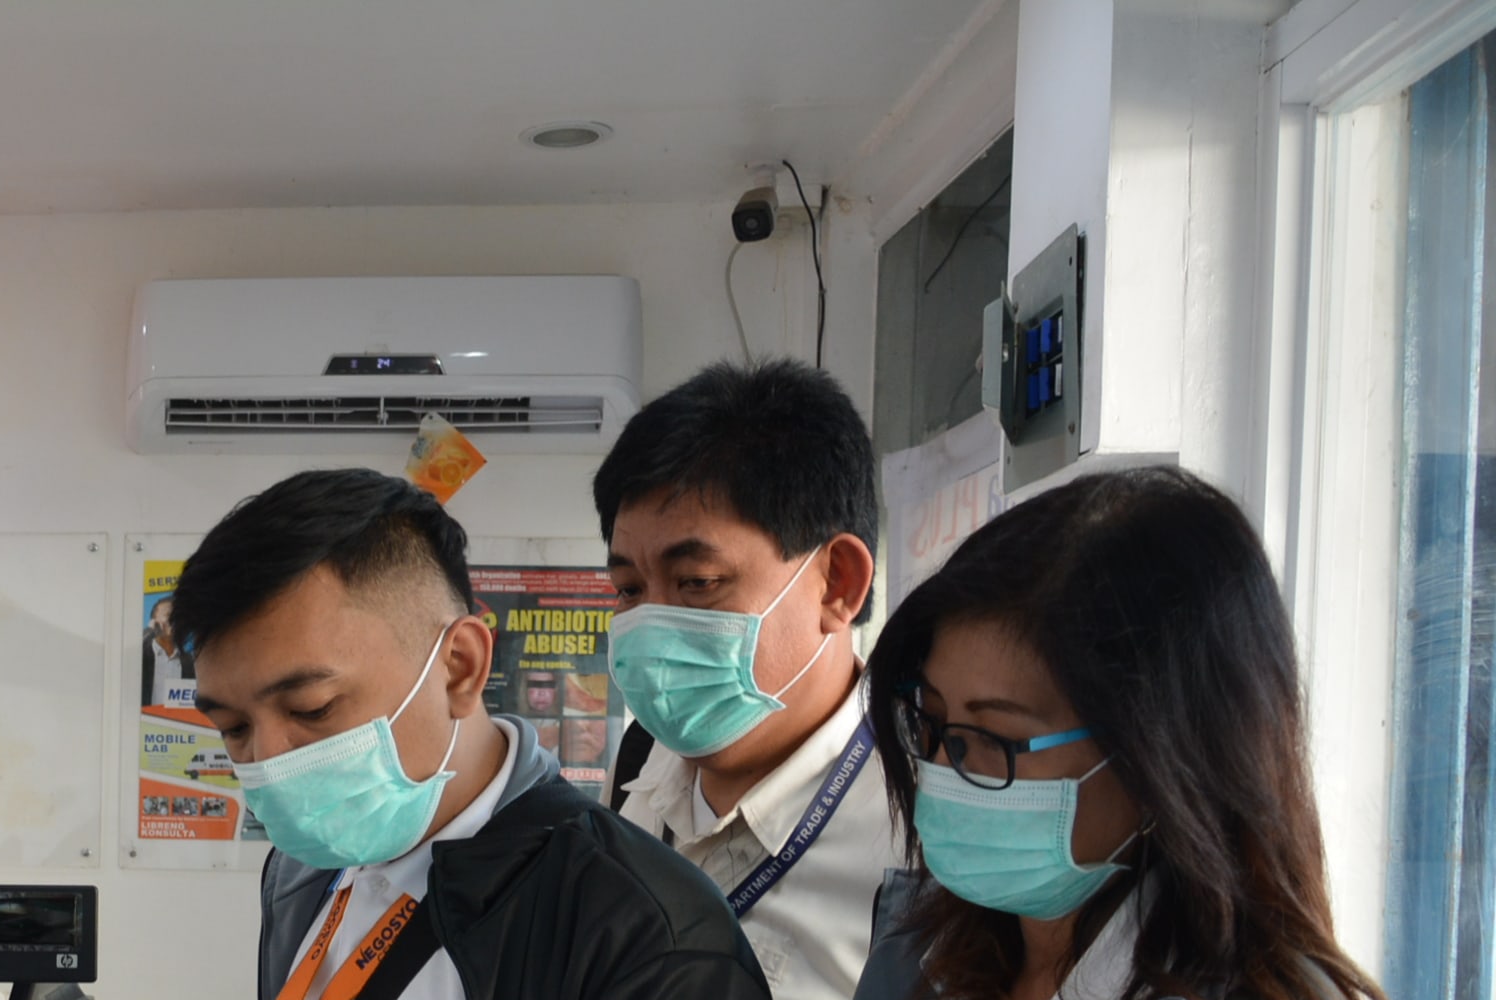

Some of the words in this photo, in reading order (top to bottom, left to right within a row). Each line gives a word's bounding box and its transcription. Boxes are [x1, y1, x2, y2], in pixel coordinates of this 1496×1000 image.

[524, 634, 596, 655] ABUSE!
[144, 734, 196, 744] MOBILE
[144, 744, 169, 753] LAB
[781, 845, 796, 862] OF
[795, 805, 827, 845] TRADE
[822, 796, 833, 806] &
[828, 740, 866, 796] INDUSTRY
[141, 829, 196, 838] KONSULTA
[356, 900, 419, 970] NEGOSYO
